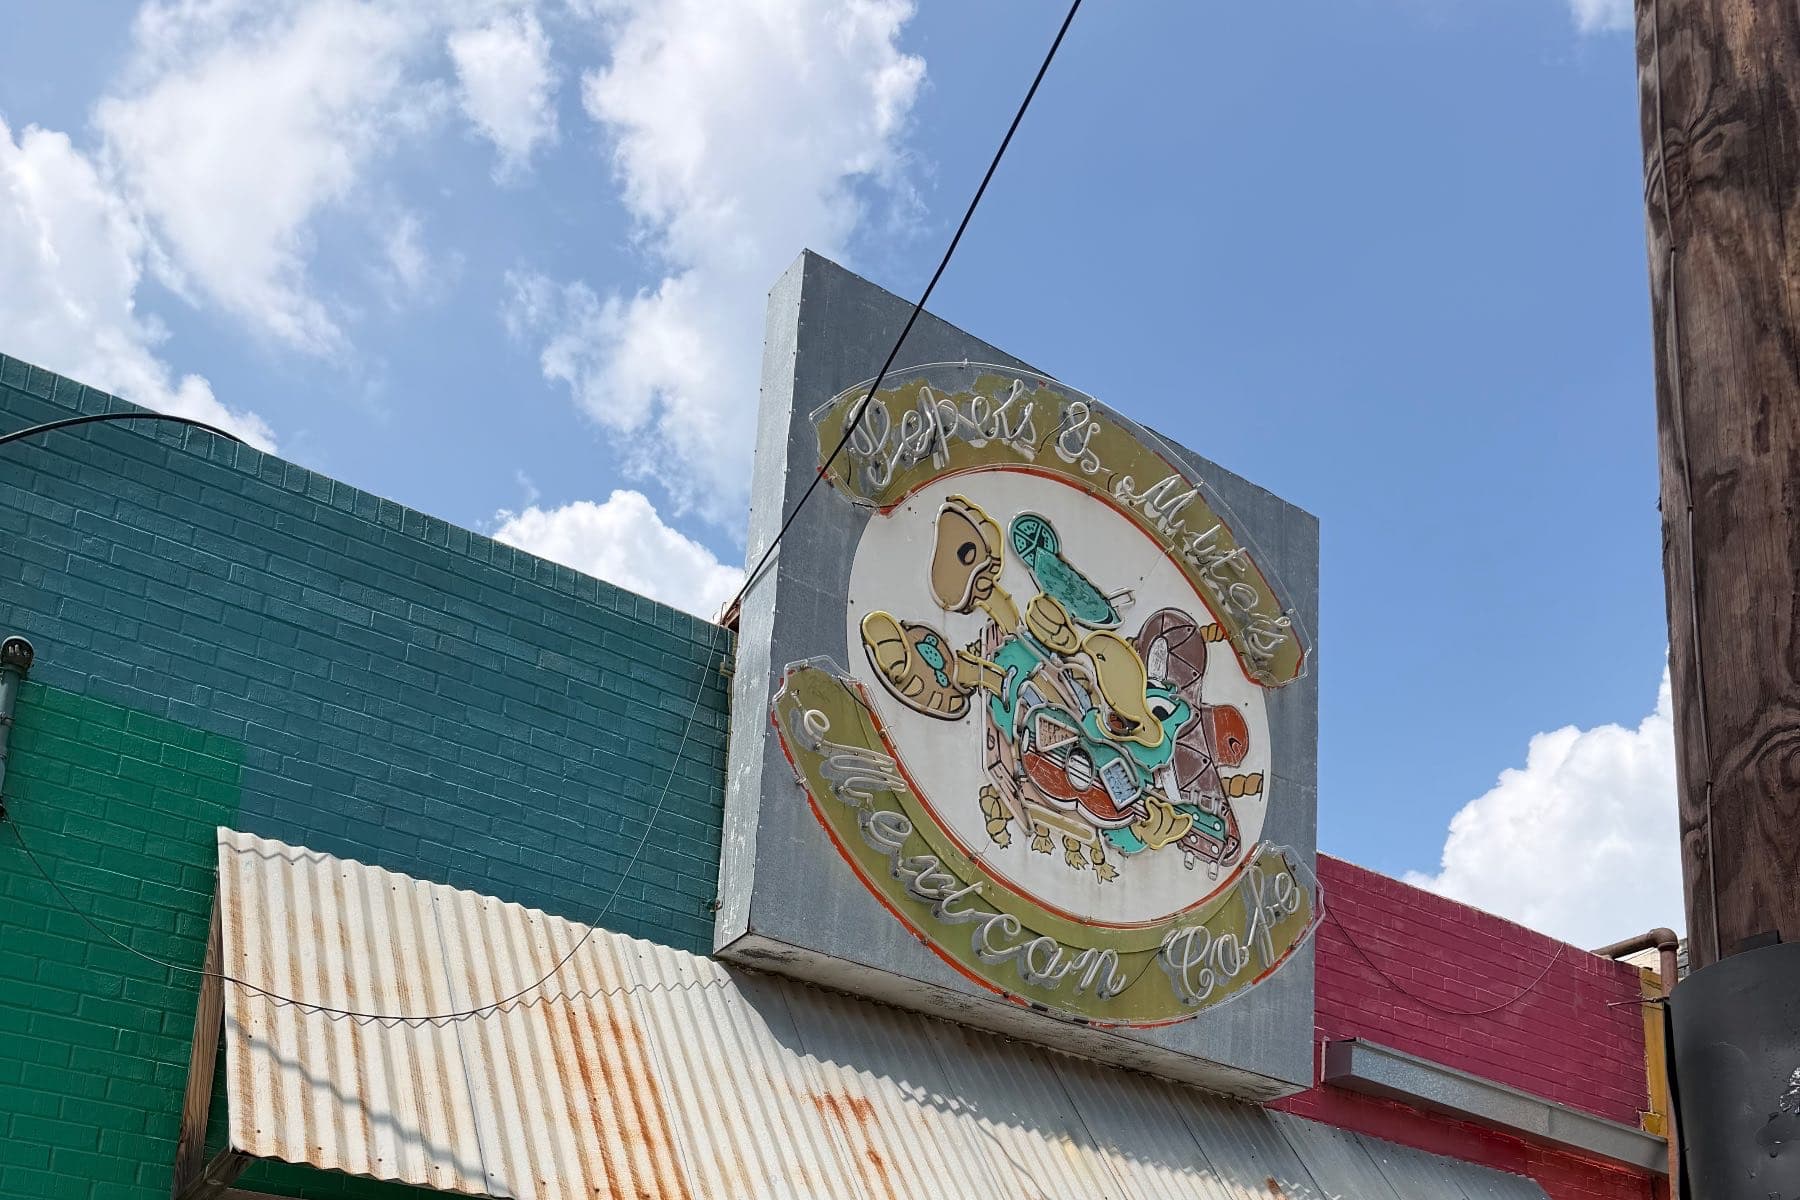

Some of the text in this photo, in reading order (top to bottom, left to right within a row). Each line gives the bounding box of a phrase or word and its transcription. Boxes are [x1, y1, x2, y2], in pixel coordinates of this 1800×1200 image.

[1059, 401, 1100, 474] &
[802, 708, 1300, 1000] Mexican Cafe
